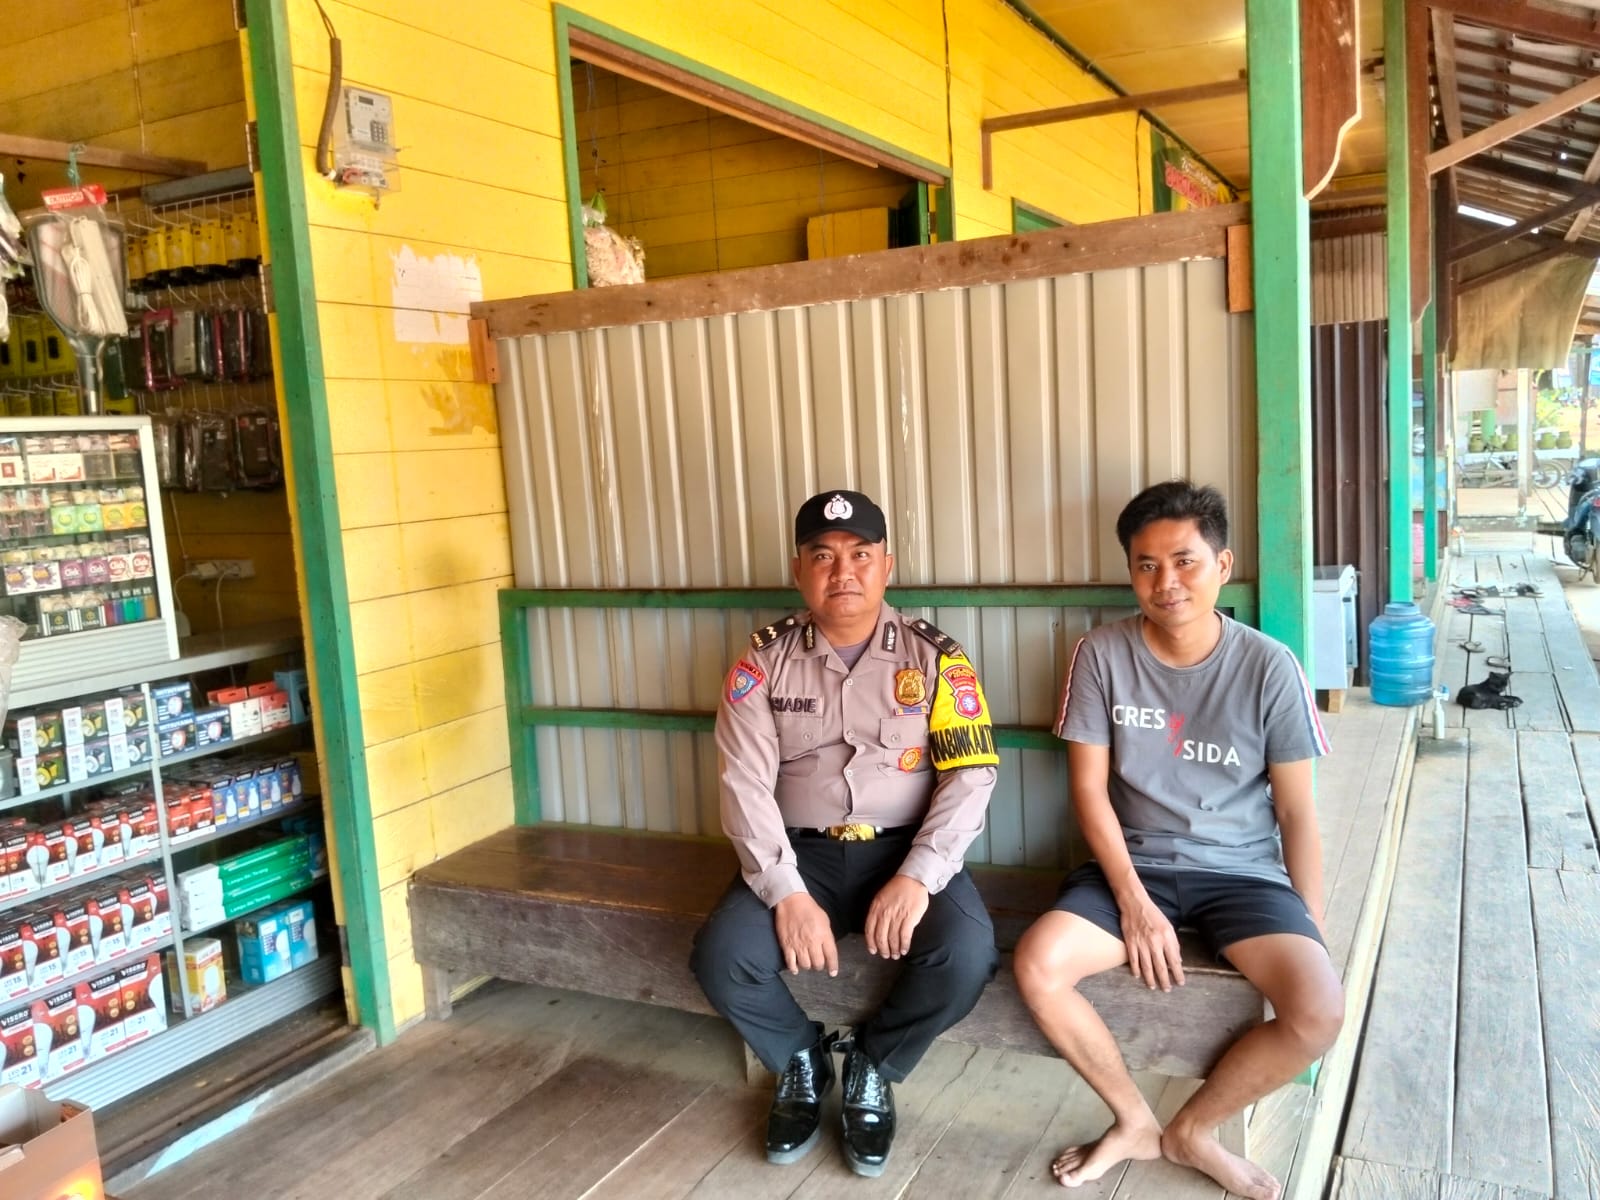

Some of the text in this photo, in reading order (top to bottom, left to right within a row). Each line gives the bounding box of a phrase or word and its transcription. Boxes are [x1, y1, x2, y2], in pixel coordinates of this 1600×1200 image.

[1112, 704, 1166, 730] CRES
[1182, 739, 1241, 767] SIDA
[34, 920, 53, 932] VISERO
[48, 963, 57, 971] 15
[121, 962, 146, 977] VISERO
[13, 976, 22, 985] 15
[91, 974, 116, 989] VISERO
[48, 991, 73, 1006] VISERO
[1, 1009, 30, 1026] VISERO
[138, 1015, 146, 1025] 21
[110, 1028, 119, 1036] 21
[68, 1045, 77, 1055] 21
[21, 1063, 33, 1076] 21
